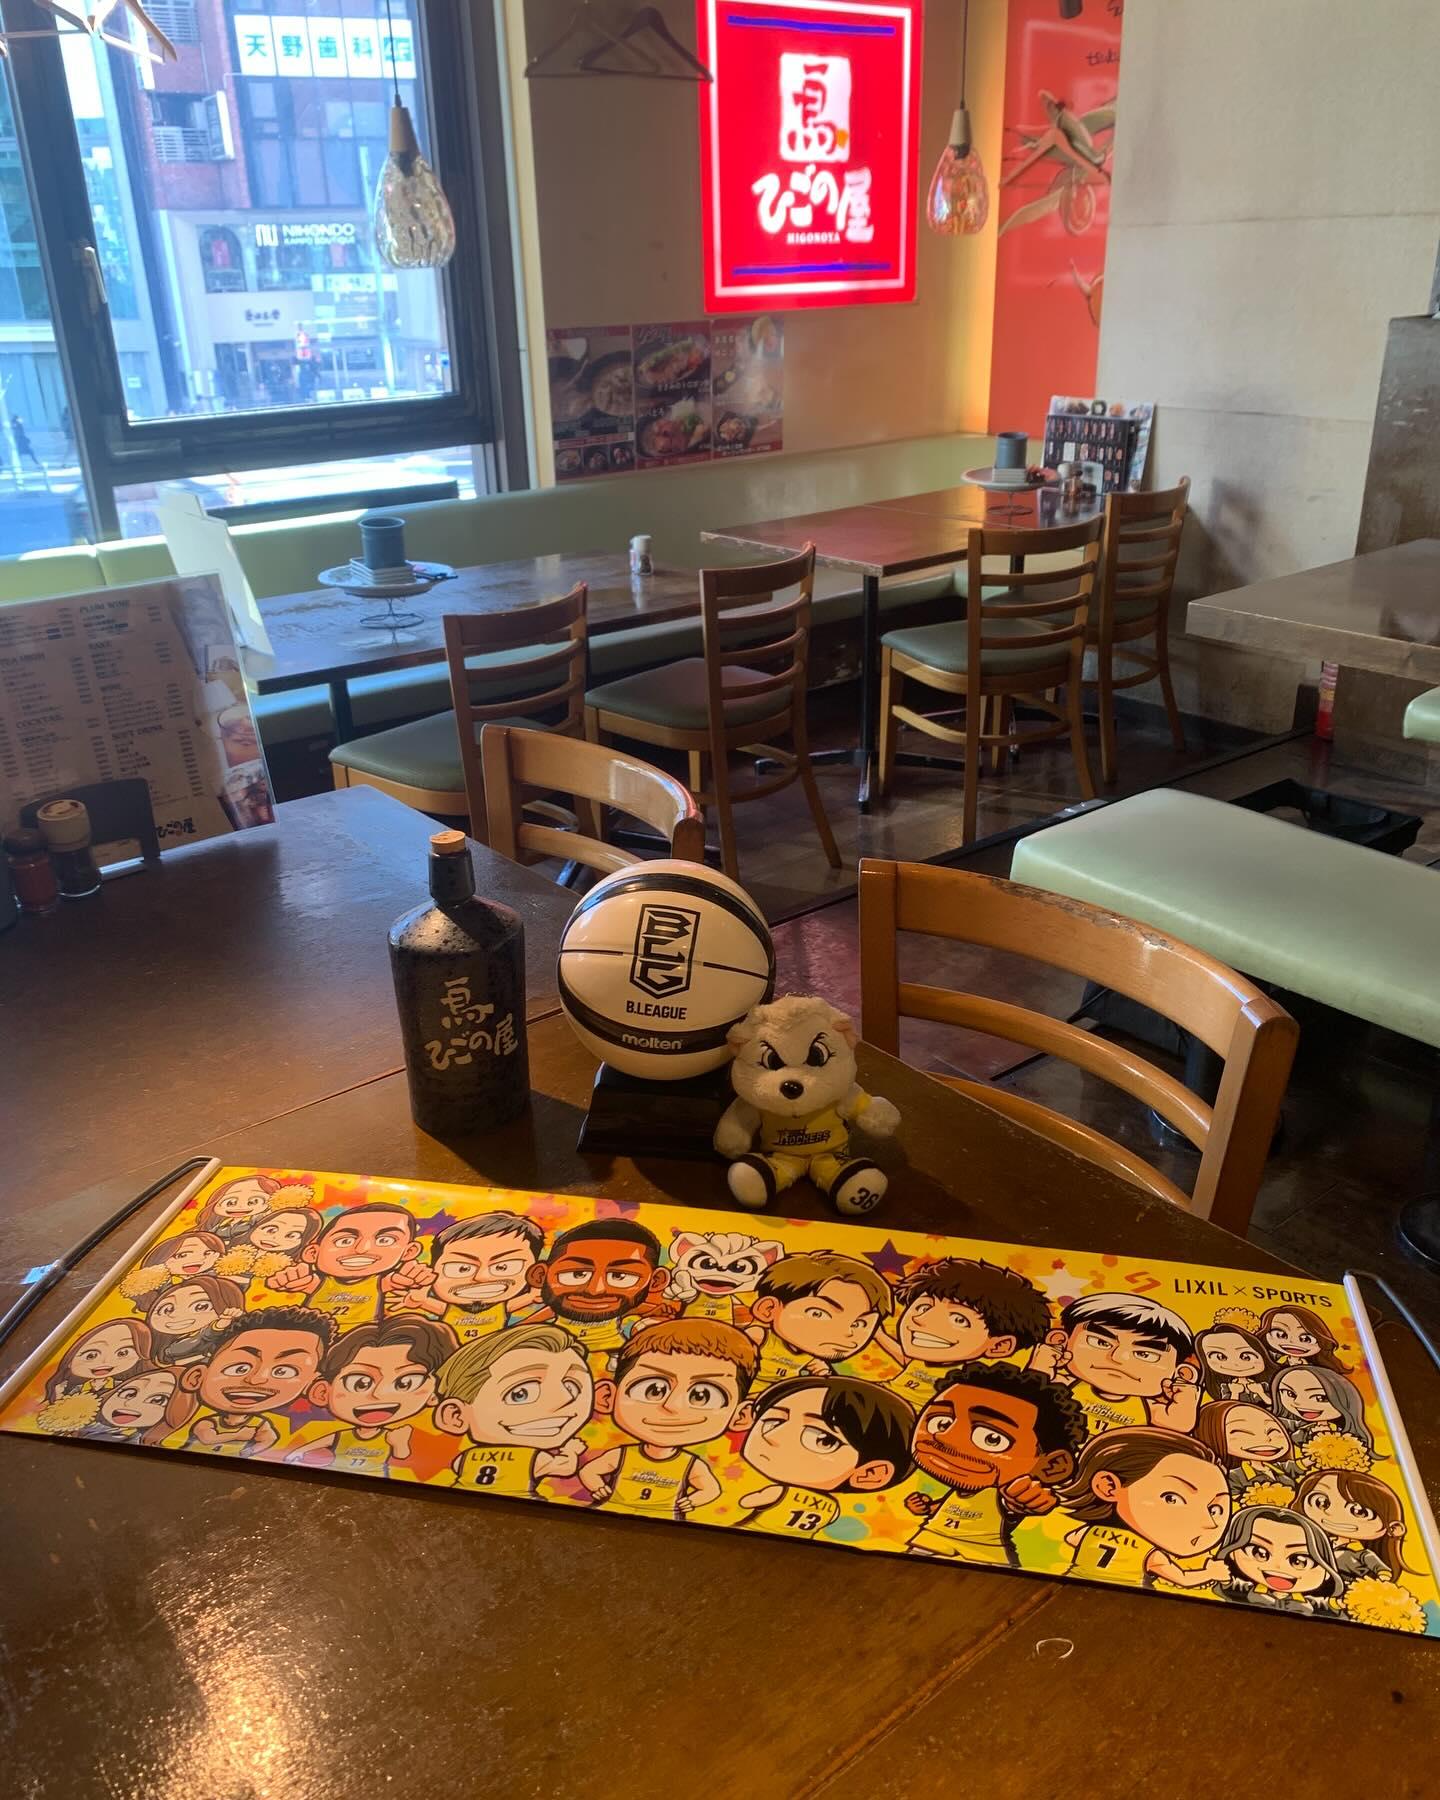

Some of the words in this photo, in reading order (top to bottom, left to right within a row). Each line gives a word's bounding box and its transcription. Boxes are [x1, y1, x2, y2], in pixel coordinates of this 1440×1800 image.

[751, 163, 875, 243] ひごの屋
[786, 232, 841, 245] HIGONOYA
[626, 1000, 688, 1020] B.LEAGUE
[424, 1013, 519, 1071] ひごの屋
[621, 1033, 682, 1050] molten
[850, 1187, 880, 1210] 36
[1174, 1278, 1228, 1296] LIXIL
[1252, 1286, 1333, 1308] SPORTS
[331, 1306, 350, 1316] 22
[464, 1329, 479, 1338] 43
[471, 1450, 516, 1462] LIXIL
[475, 1465, 498, 1485] 8
[640, 1487, 652, 1500] 9
[793, 1492, 833, 1513] LIXIL
[786, 1510, 822, 1531] 13
[944, 1517, 960, 1529] 21
[1092, 1527, 1139, 1549] LIXIL
[1096, 1543, 1118, 1569] 7
